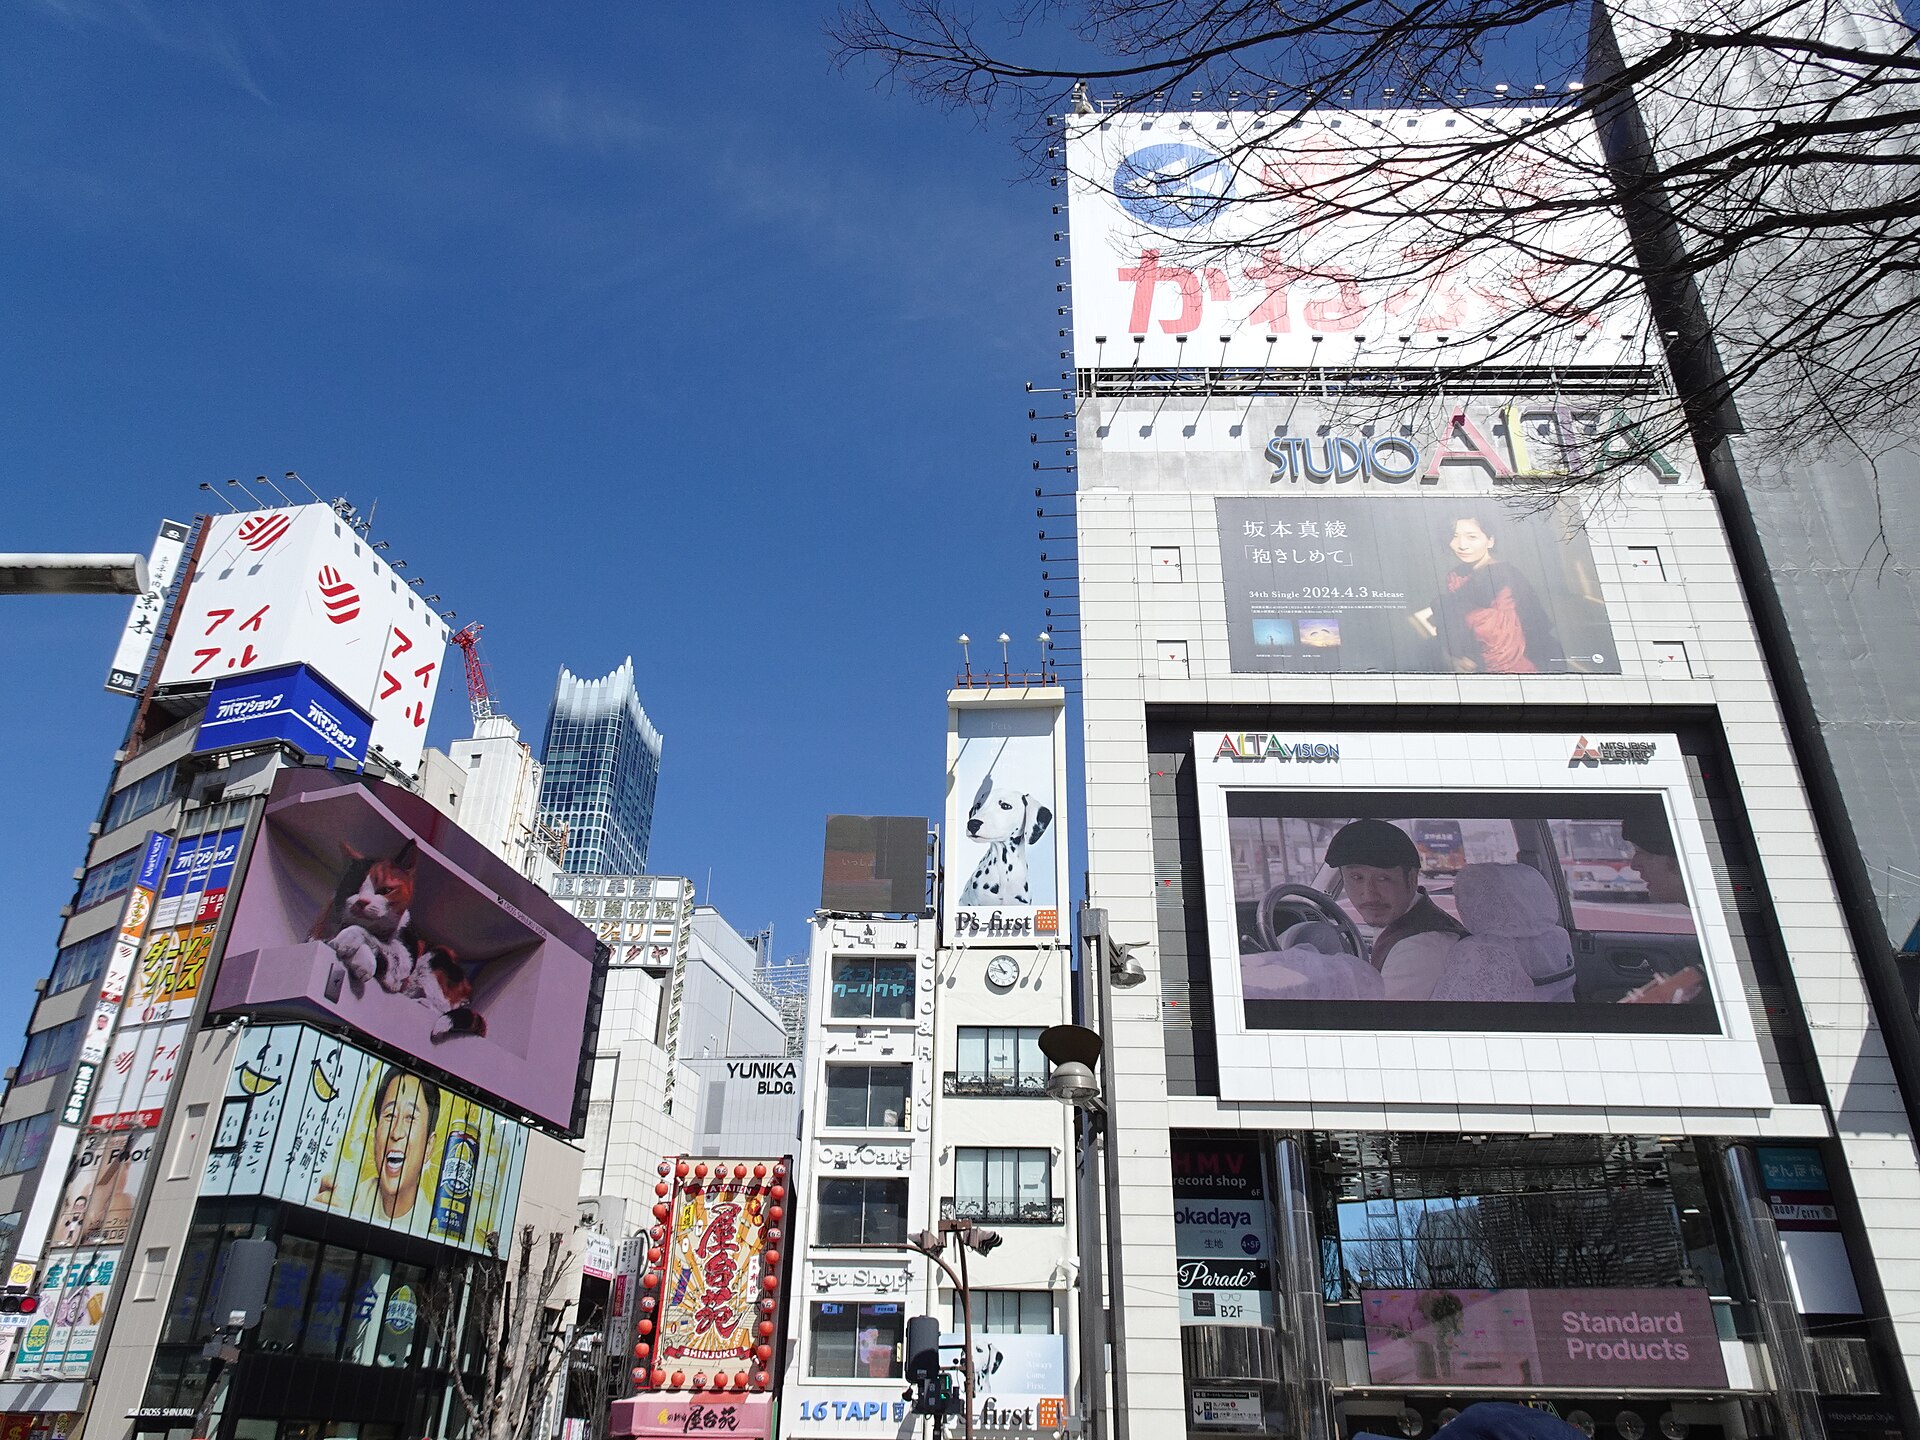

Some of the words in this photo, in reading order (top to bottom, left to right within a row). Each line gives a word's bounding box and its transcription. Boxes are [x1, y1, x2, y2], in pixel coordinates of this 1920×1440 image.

[1267, 436, 1419, 480] STUDIO
[1422, 405, 1680, 483] ALTA
[1242, 520, 1349, 538] 坂本真綾
[1244, 544, 1354, 567] 「抱きしめて」
[1249, 590, 1269, 598] 34th
[1271, 590, 1300, 600] Single
[1302, 586, 1369, 598] 2024.4.3
[1372, 590, 1405, 598] Release
[216, 693, 284, 719] アパマンショップ
[307, 704, 357, 749] アパマンショップ
[1600, 742, 1656, 751] MITSUBISHI
[1602, 750, 1653, 759] ELECTRIC
[555, 877, 651, 896] 服飾手芸
[577, 899, 675, 919] 洋装材料
[202, 923, 217, 935] 5F
[588, 921, 672, 941] ジェリー
[726, 1062, 797, 1079] YUNIKA
[79, 1151, 102, 1168] Dr
[1173, 1152, 1245, 1175] HMV
[703, 1183, 752, 1195] YATAIEN
[1174, 1175, 1213, 1187] record
[1216, 1175, 1247, 1189] shop
[1251, 1188, 1261, 1196] 6F
[1175, 1207, 1251, 1229] okadaya
[1203, 1238, 1224, 1249] 生地
[694, 1202, 741, 1340] 屋台苑
[852, 1269, 910, 1291] Shop
[1177, 1260, 1257, 1288] Parade
[1221, 1306, 1243, 1318] B2F
[1562, 1310, 1684, 1335] Standard
[683, 1348, 738, 1359] SHINJUKU
[1566, 1337, 1689, 1361] Products
[140, 1408, 161, 1416] CROSS
[162, 1408, 195, 1417] SHINJUKU
[683, 1405, 740, 1434] 屋台苑
[799, 1400, 828, 1421] 16
[831, 1400, 888, 1421] TAPI
